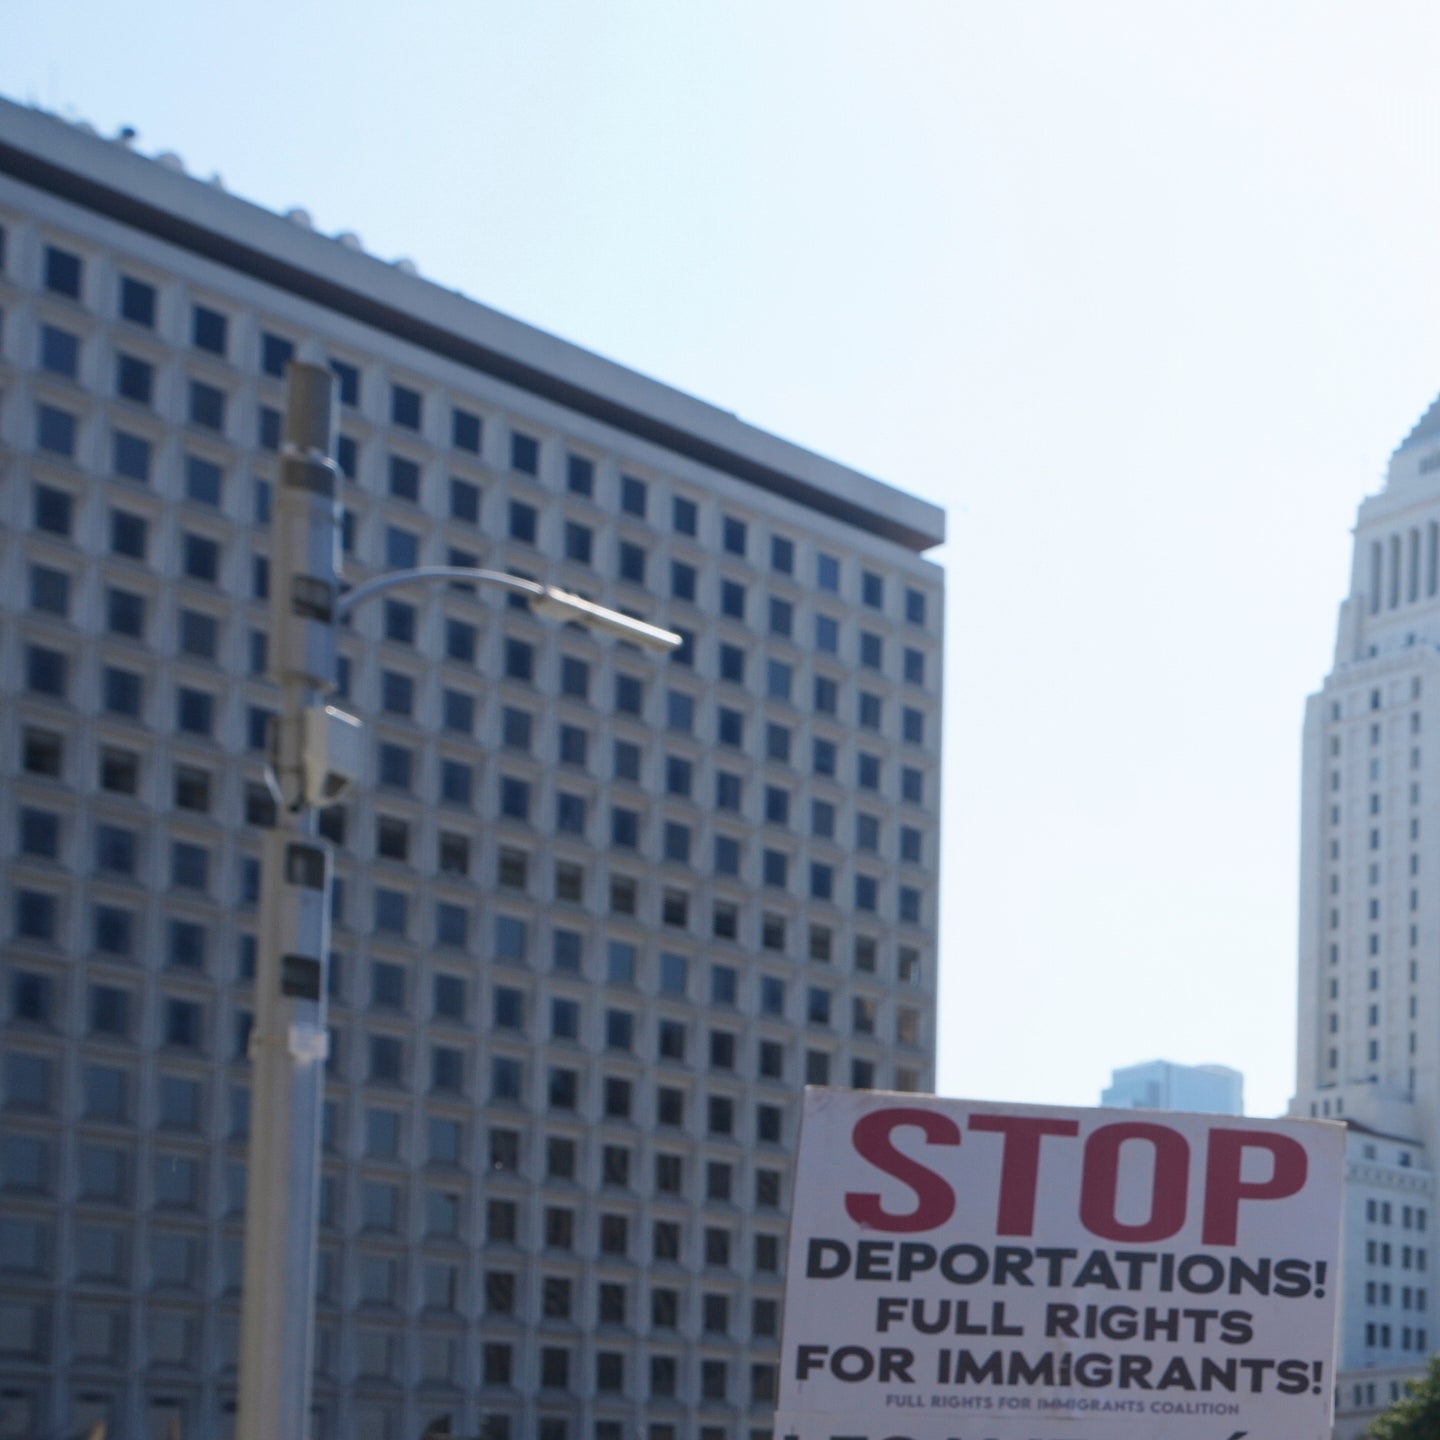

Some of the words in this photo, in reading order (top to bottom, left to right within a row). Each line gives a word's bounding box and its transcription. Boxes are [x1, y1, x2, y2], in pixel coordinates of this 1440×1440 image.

[844, 1108, 1308, 1246] STOP
[805, 1238, 1327, 1299] DEPORTATIONS!
[876, 1297, 1023, 1337] FULL
[1045, 1302, 1254, 1344] RIGHTS
[796, 1345, 916, 1384] FOR
[937, 1350, 1323, 1395] IMMIGRANTS!
[885, 1394, 926, 1409] FULL
[930, 1395, 992, 1411] RIGHTS
[998, 1396, 1031, 1411] FOR
[1036, 1397, 1146, 1415] IMMIGRANTS
[1150, 1400, 1240, 1416] COALITION
